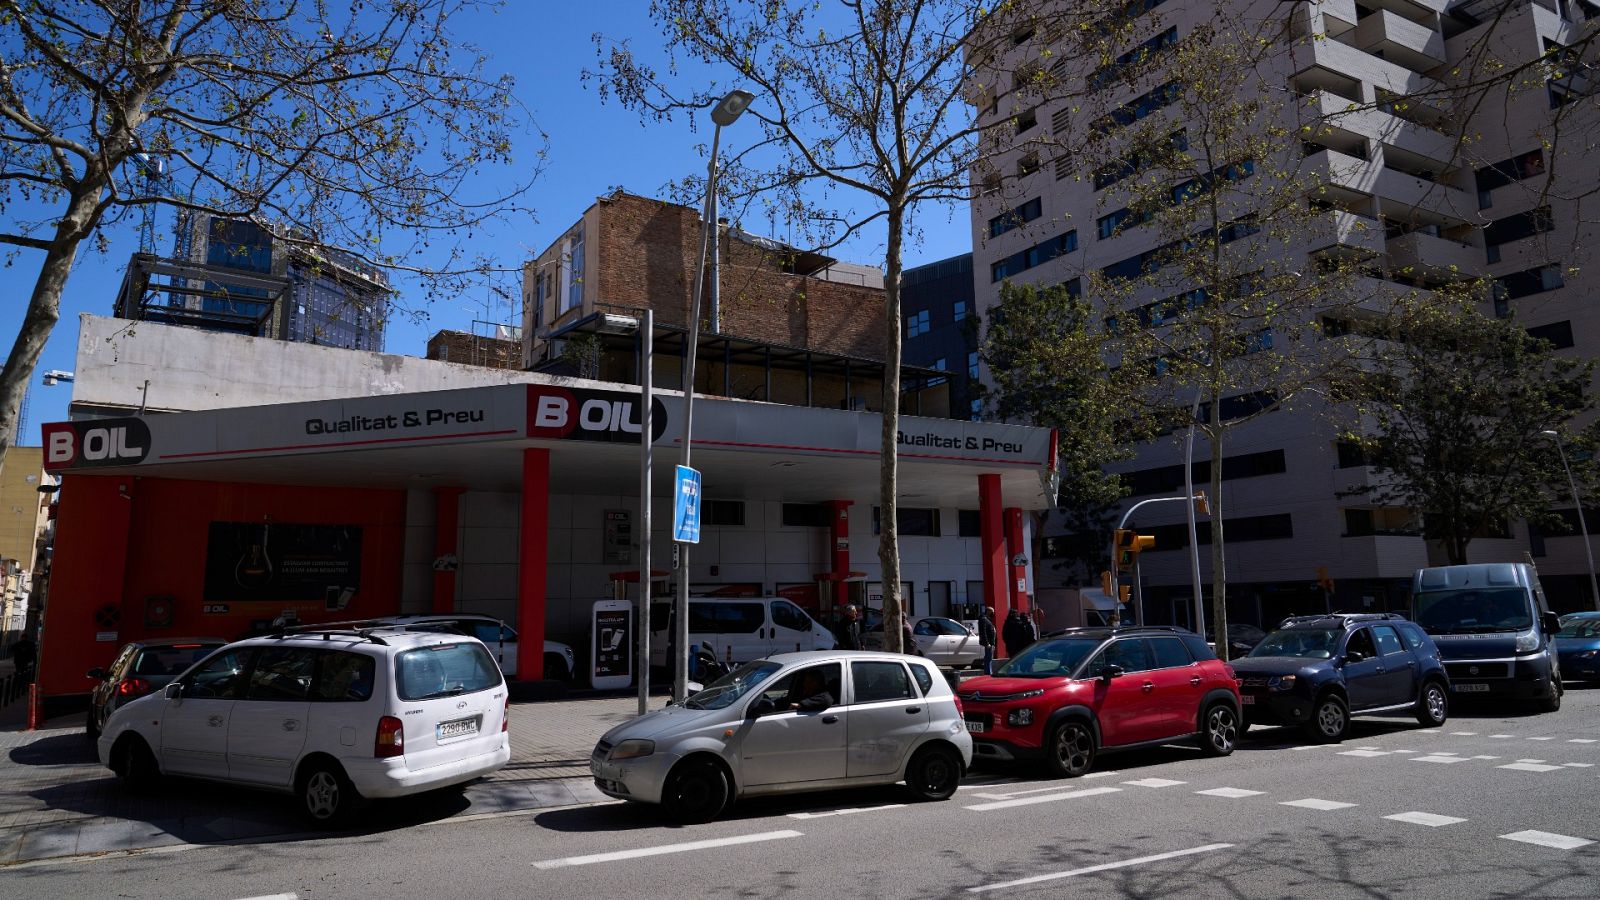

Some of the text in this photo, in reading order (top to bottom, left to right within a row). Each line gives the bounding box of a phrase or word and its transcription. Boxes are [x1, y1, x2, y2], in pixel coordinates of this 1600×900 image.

[305, 409, 484, 435] Qualitat & Preu
[534, 395, 642, 433] B OIL
[48, 426, 143, 464] B OIL
[965, 437, 979, 450] &
[983, 438, 1023, 453] Preu
[442, 723, 460, 735] 2290
